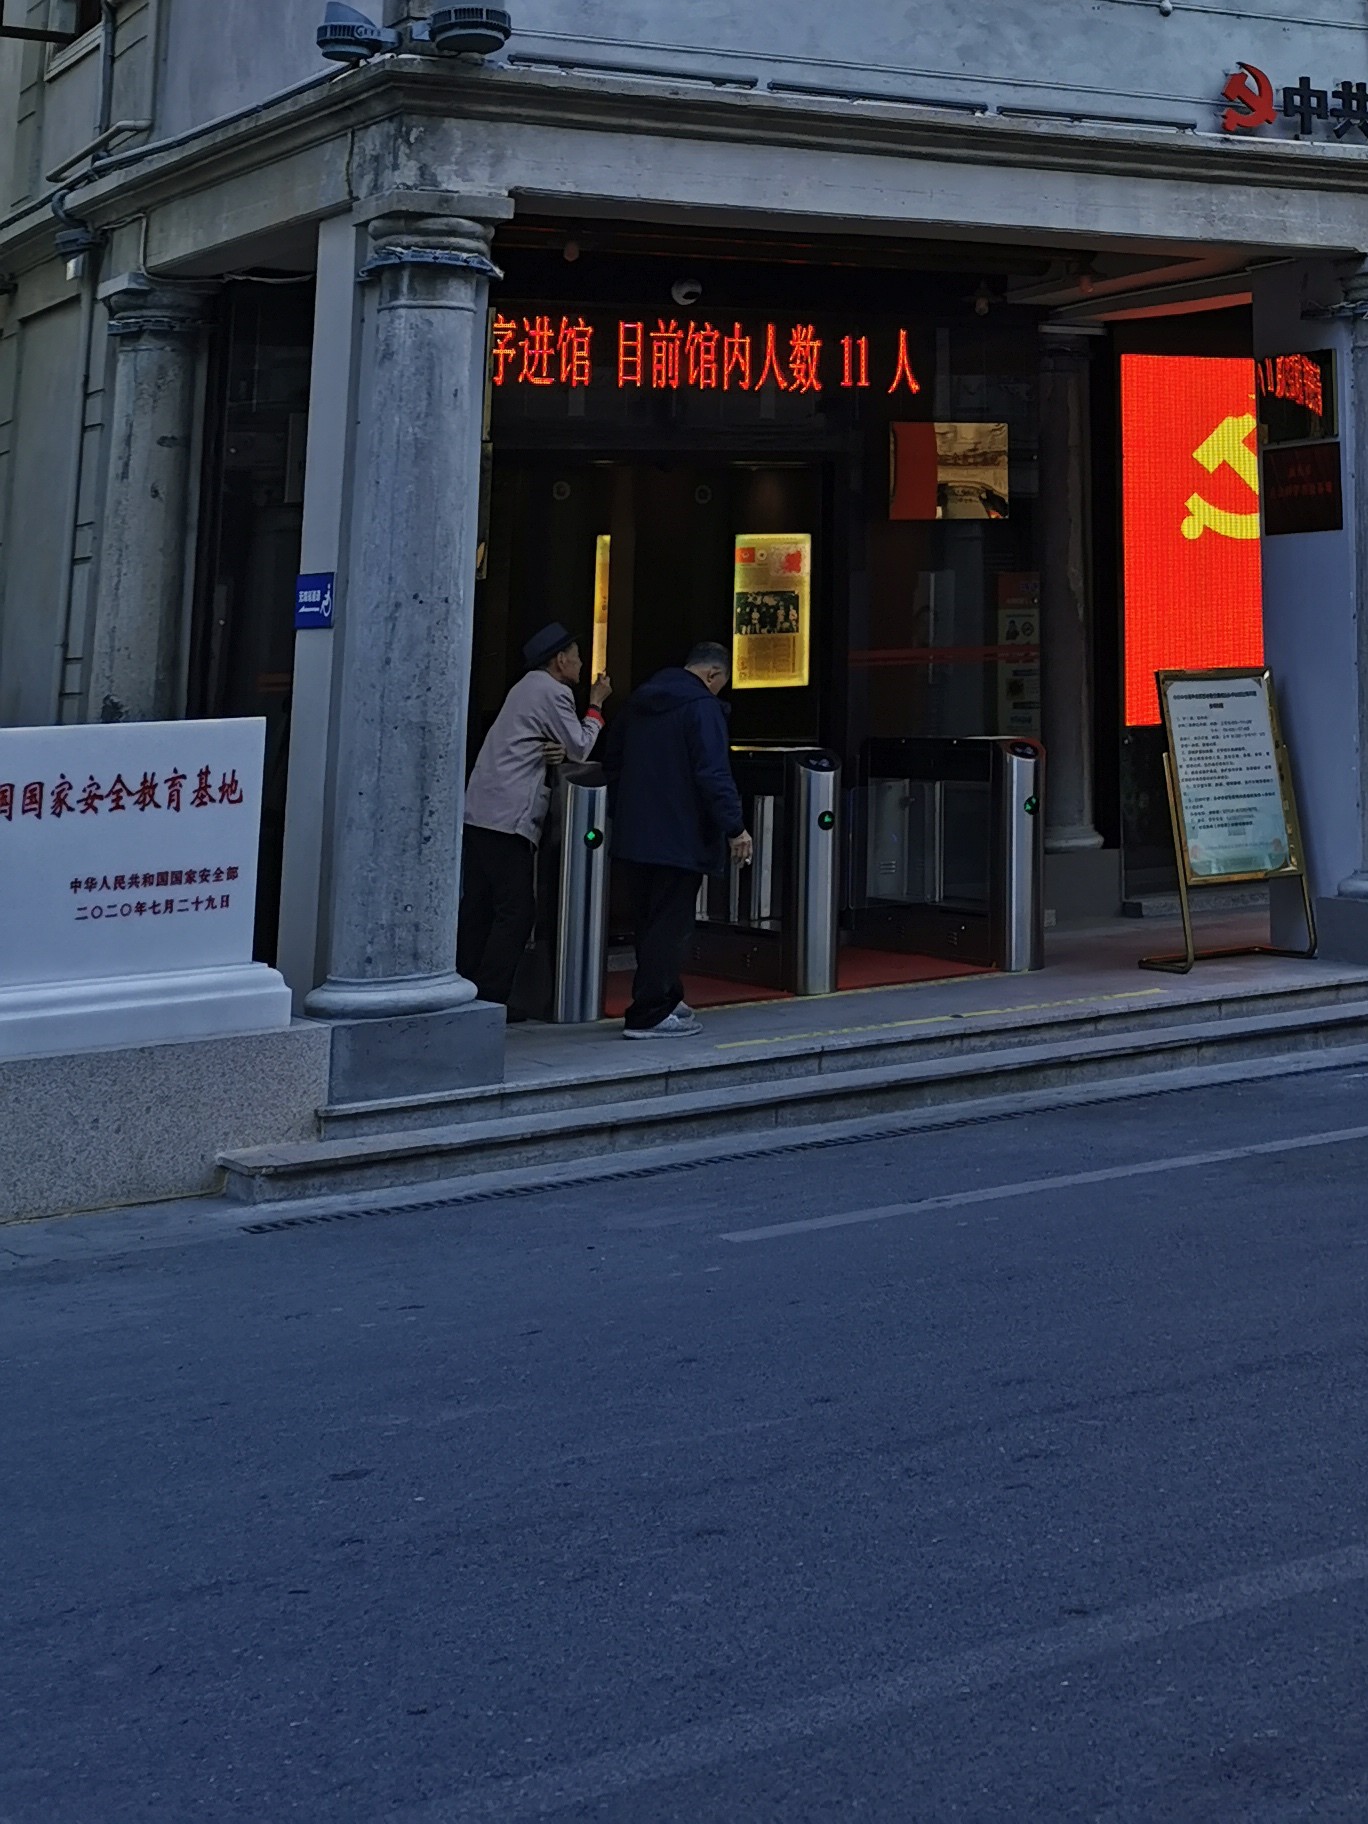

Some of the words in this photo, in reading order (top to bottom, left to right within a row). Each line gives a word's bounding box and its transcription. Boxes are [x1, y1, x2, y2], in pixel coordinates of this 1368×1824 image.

[618, 318, 822, 393] 目前馆内人数
[840, 335, 870, 387] 11
[888, 328, 921, 394] 人
[69, 866, 239, 895] 中华人民共和国国家安全部
